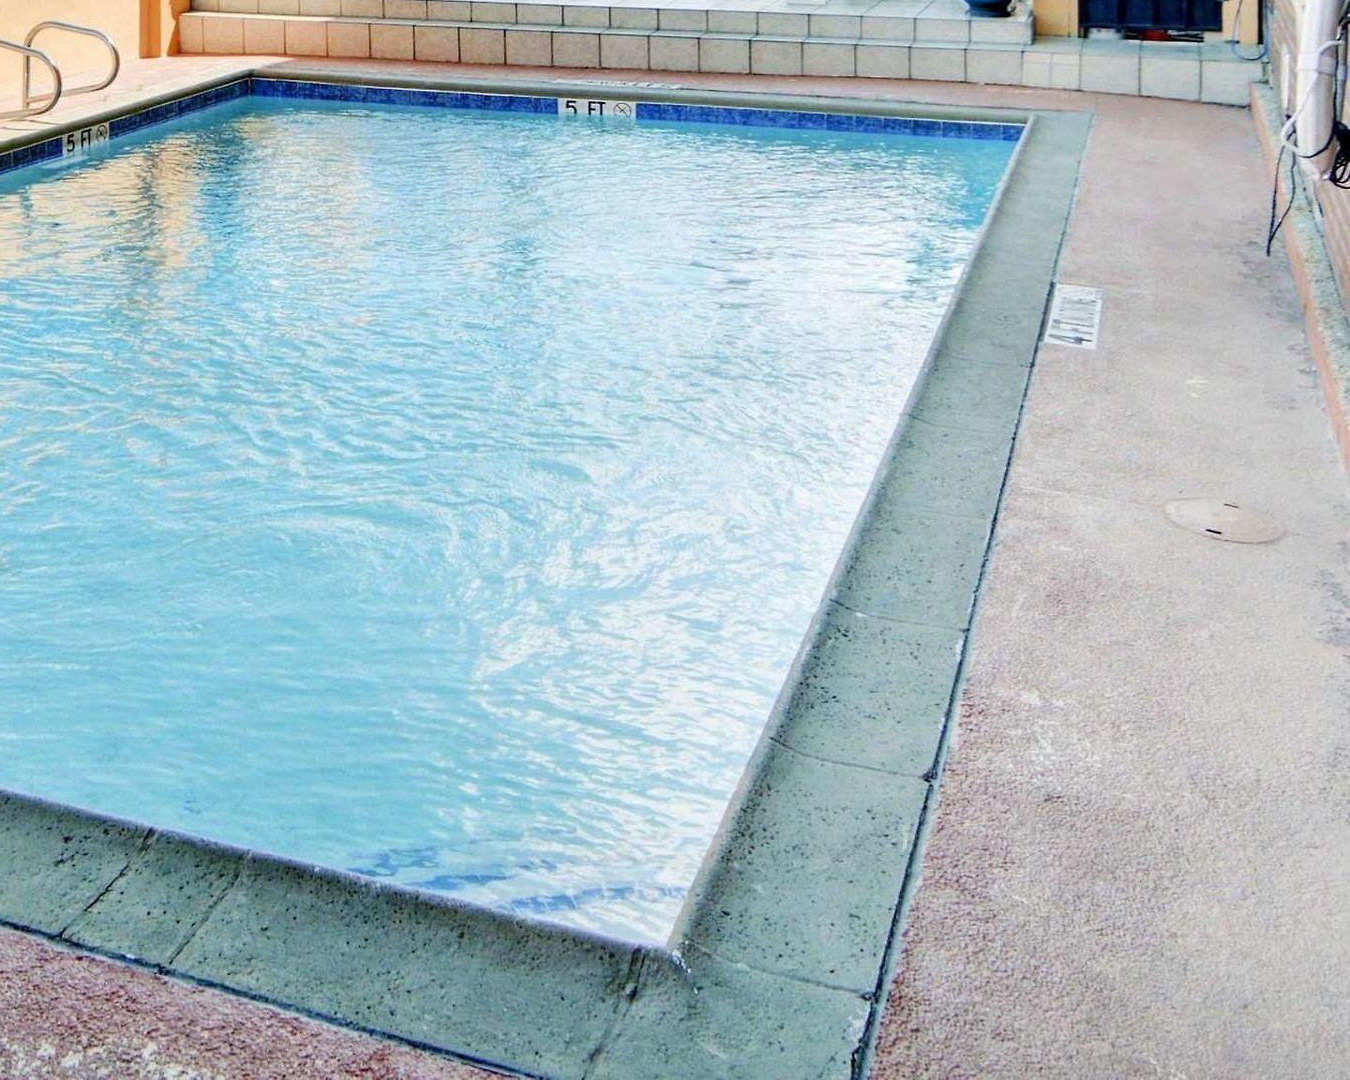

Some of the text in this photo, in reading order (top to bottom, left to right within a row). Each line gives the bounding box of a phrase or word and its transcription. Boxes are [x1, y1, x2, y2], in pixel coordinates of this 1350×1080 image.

[588, 101, 606, 116] FT
[67, 128, 92, 152] 5 FT
